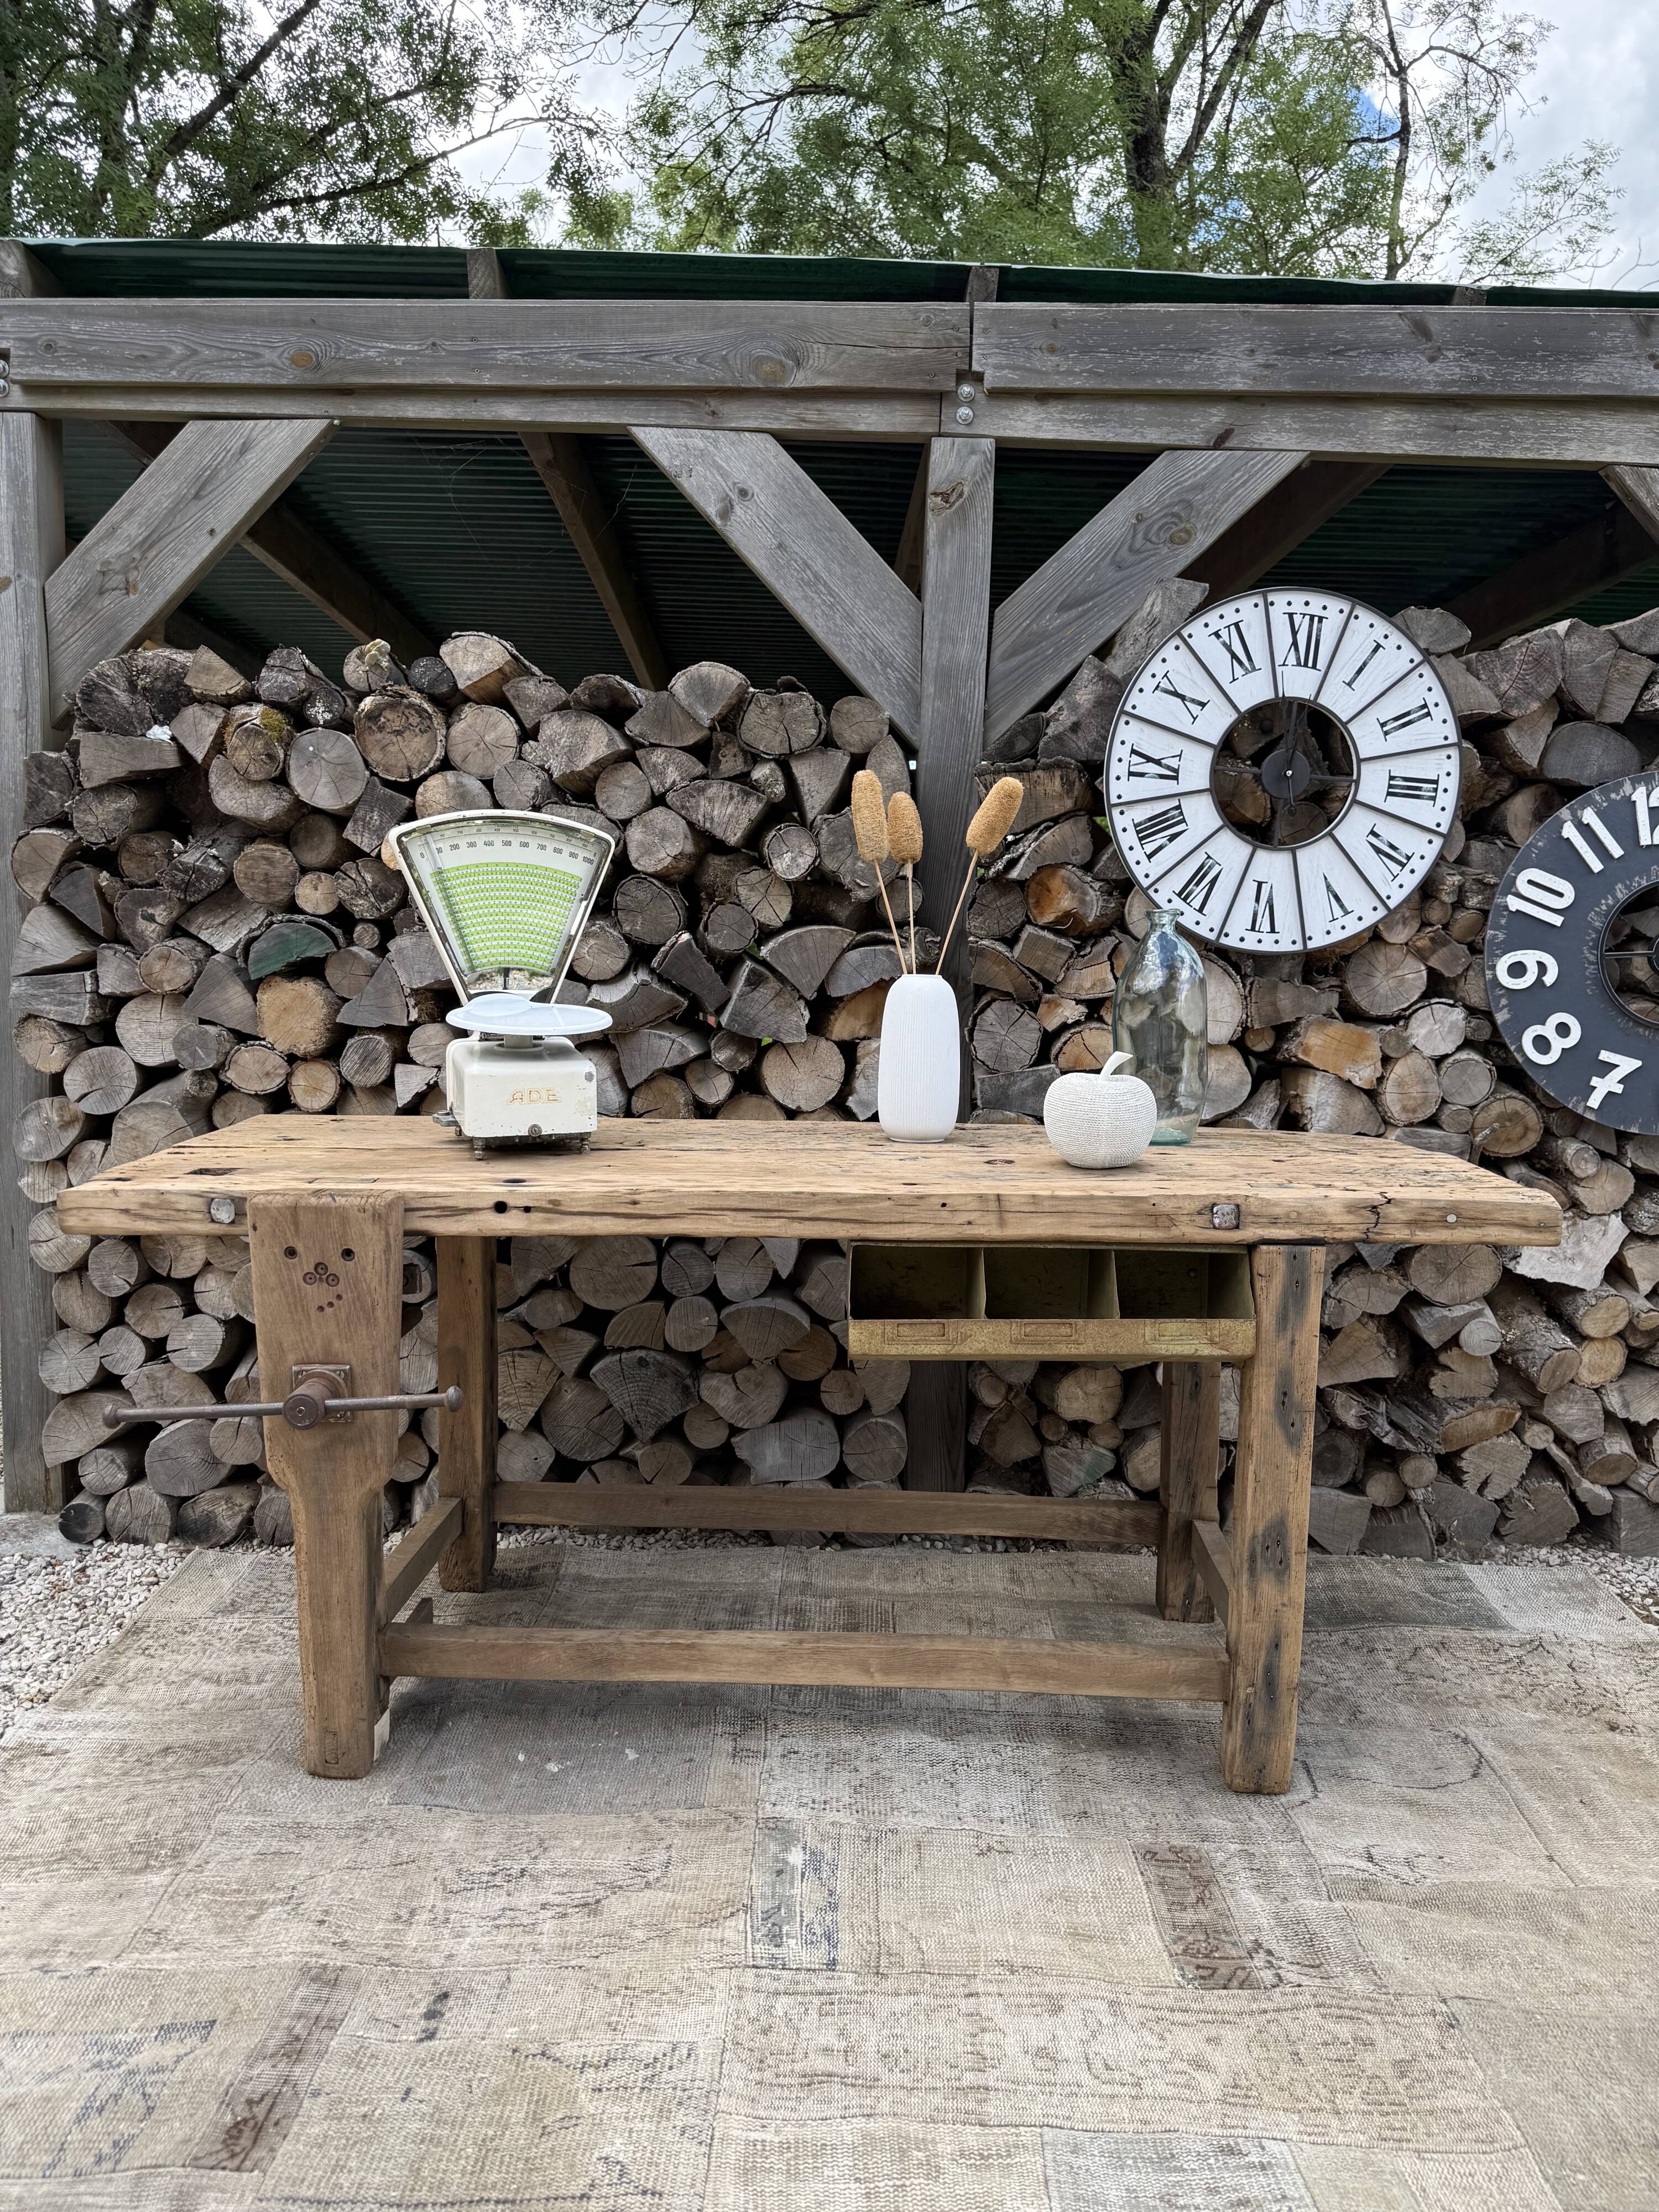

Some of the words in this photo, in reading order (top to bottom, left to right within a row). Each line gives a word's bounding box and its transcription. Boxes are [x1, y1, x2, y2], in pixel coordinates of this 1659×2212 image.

[1208, 620, 1261, 684] XI
[1278, 612, 1329, 671] XII
[1343, 640, 1385, 691] I
[1152, 671, 1210, 724] X
[1377, 698, 1433, 742] II
[1127, 743, 1183, 785] IX
[1384, 769, 1439, 807] III
[1132, 799, 1189, 862] VIII
[1366, 823, 1415, 881] IV
[1561, 806, 1625, 874] 11
[568, 851, 578, 859] 900
[582, 856, 594, 865] 1000
[1173, 852, 1223, 916] VII
[1245, 880, 1280, 933] VI
[1323, 873, 1354, 922] V
[1506, 868, 1575, 927] 10
[1495, 949, 1558, 990] 9
[1521, 1012, 1582, 1065] 8
[507, 1088, 562, 1105] ADE
[1586, 1050, 1642, 1110] 7
